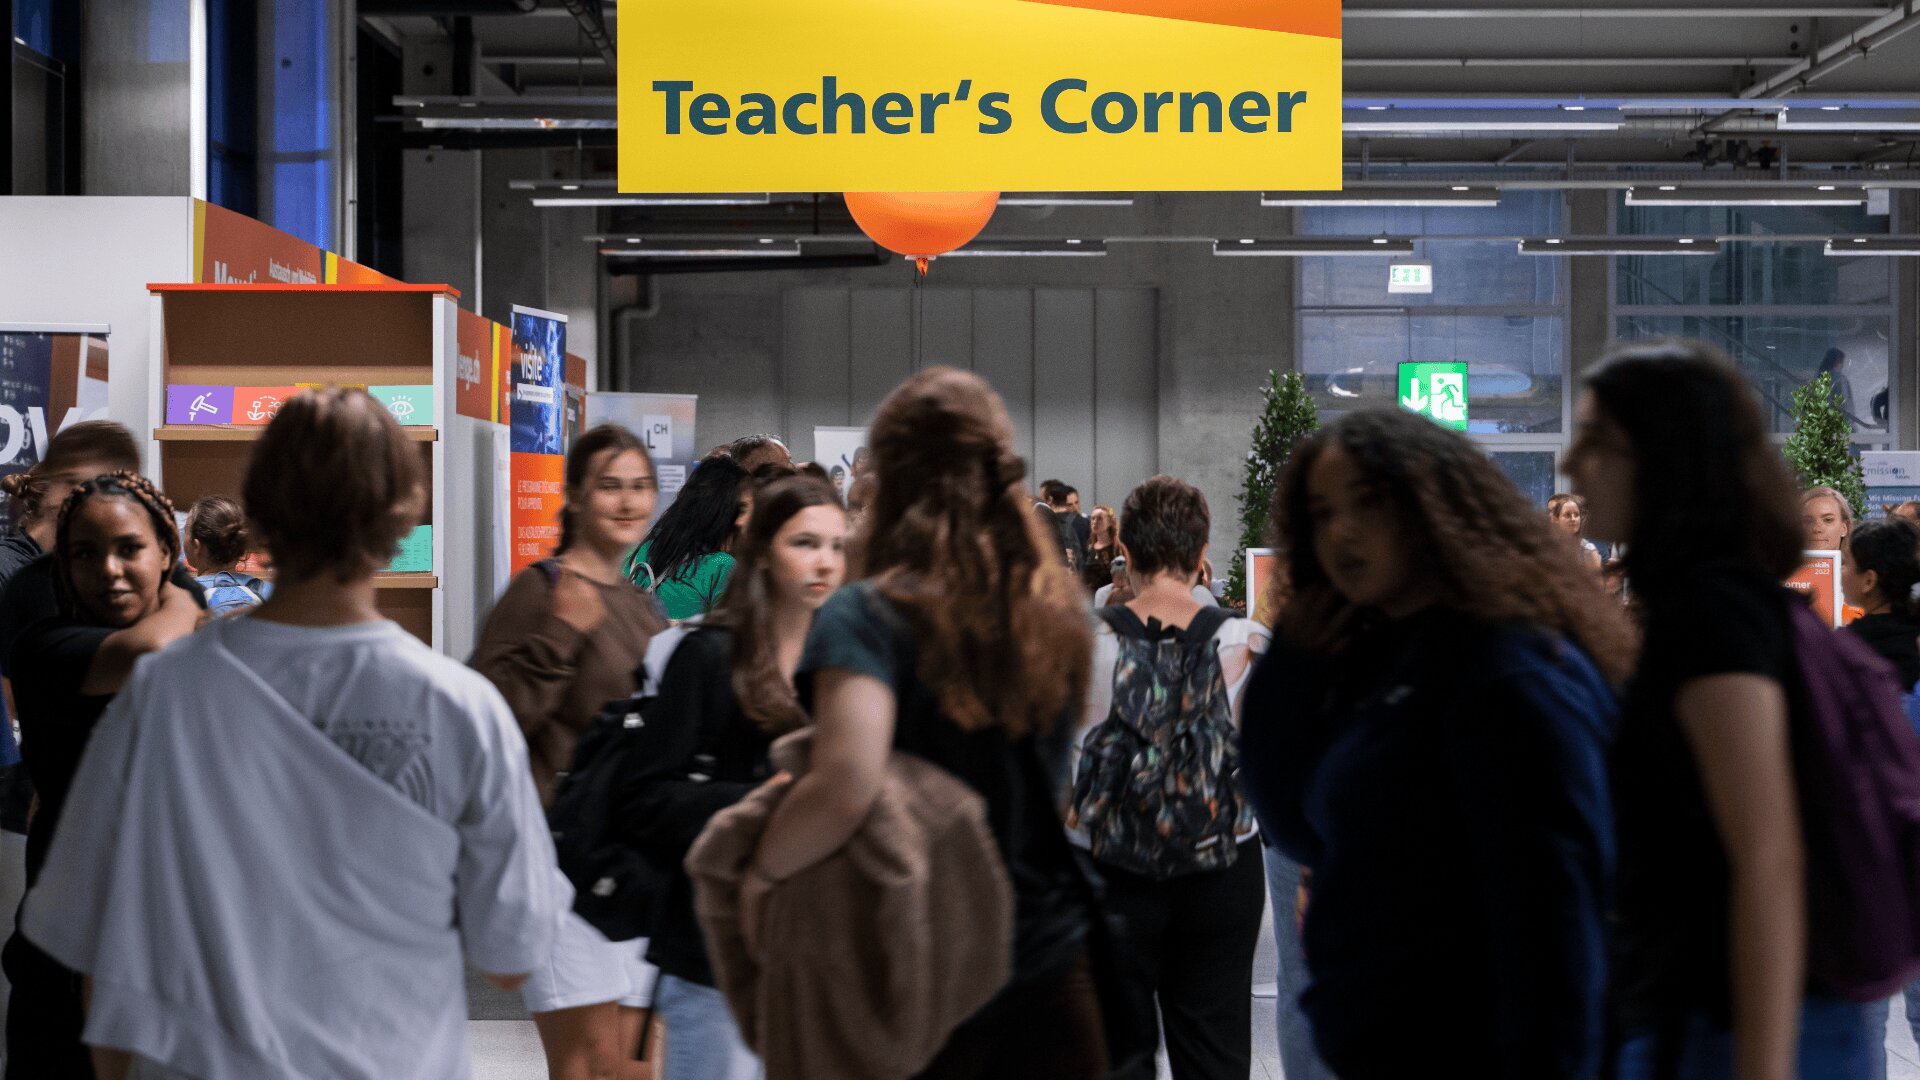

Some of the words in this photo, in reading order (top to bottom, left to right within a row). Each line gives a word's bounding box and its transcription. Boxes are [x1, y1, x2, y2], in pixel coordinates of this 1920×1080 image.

[652, 76, 1013, 136] Teacher's
[1041, 78, 1307, 135] Corner
[520, 342, 543, 382] visite
[1782, 581, 1811, 589] orner
